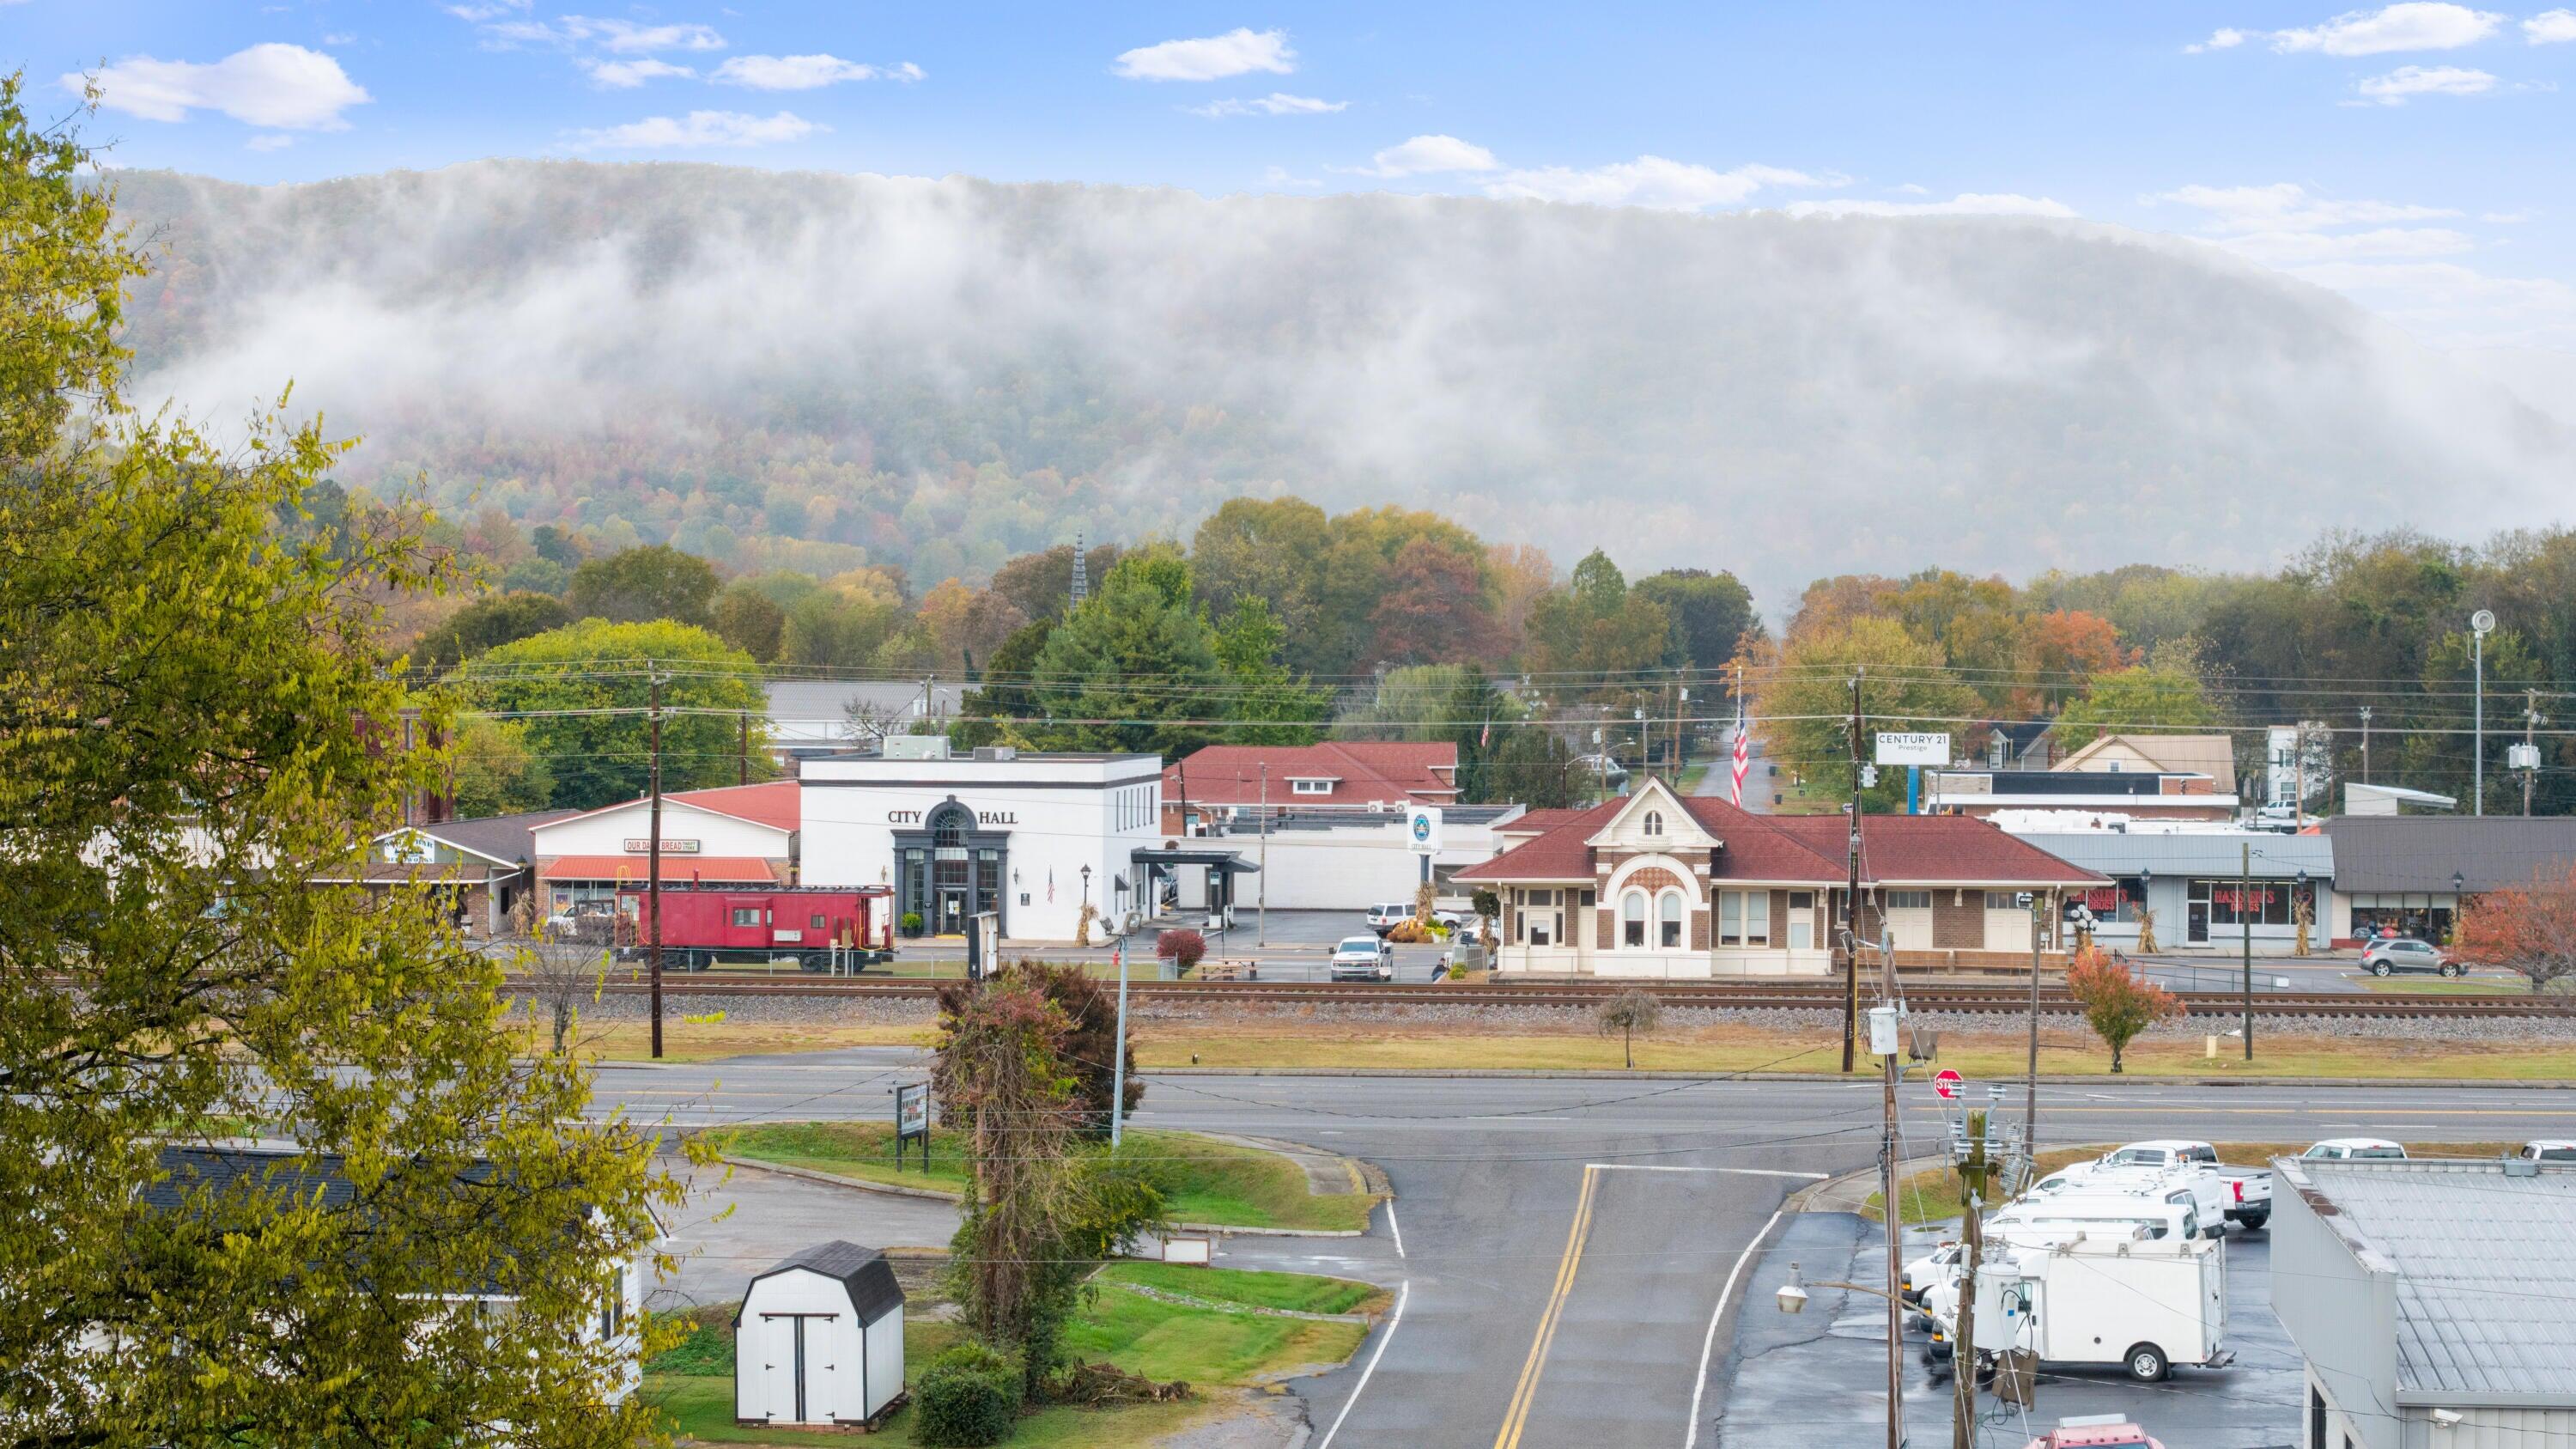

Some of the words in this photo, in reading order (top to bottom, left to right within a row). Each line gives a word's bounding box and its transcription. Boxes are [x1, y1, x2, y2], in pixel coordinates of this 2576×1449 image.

[1879, 734, 1933, 744] CENTURY
[1936, 735, 1947, 744] 21
[1899, 744, 1928, 752] Prestige
[888, 811, 921, 823] CITY
[979, 812, 1018, 824] HALL
[627, 841, 641, 850] OUR
[661, 841, 683, 850] BREAD
[2214, 890, 2275, 903] HASSER'S
[2088, 900, 2116, 910] DRUGS
[2230, 901, 2260, 912] DRGS
[1936, 1078, 1961, 1090] ST
